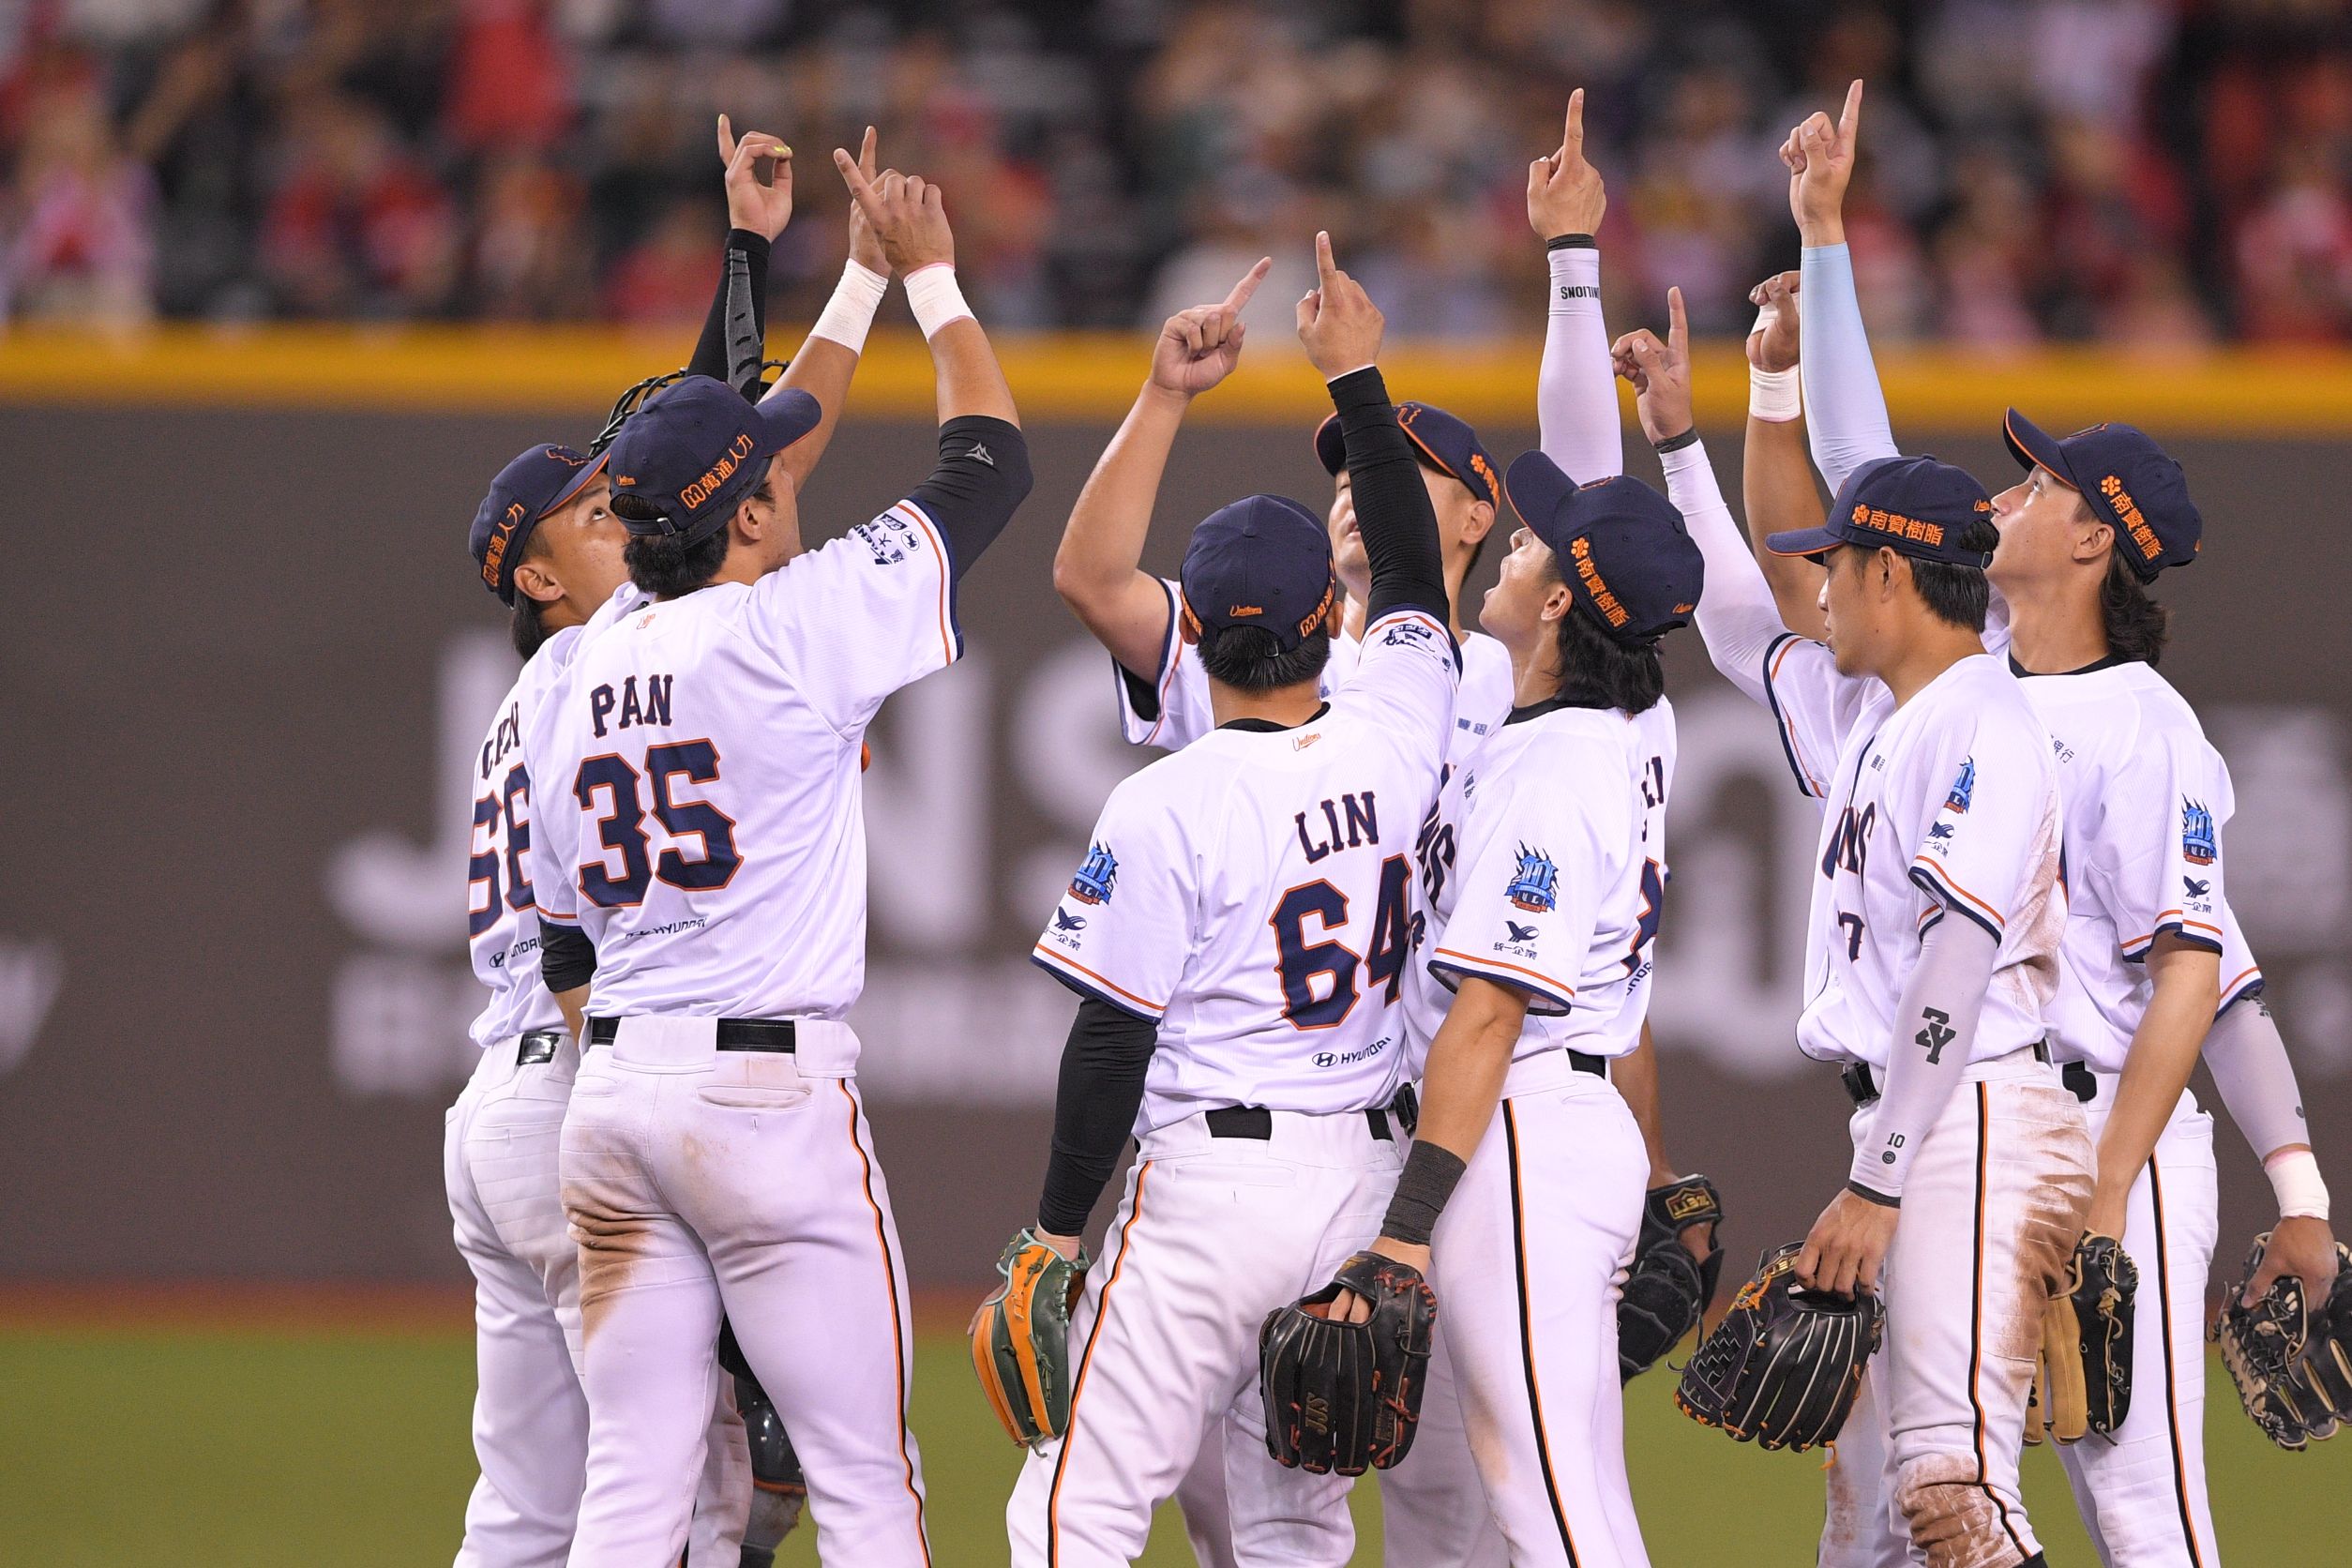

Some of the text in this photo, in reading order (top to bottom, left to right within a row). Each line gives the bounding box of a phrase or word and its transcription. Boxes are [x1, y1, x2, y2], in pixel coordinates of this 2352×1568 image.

[1868, 509, 1945, 547] 南寶樹脂
[590, 673, 673, 739] PAN
[572, 737, 745, 908] 35
[1295, 791, 1380, 864] LIN
[1269, 852, 1411, 1031] 64
[1887, 1132, 1906, 1149] 10
